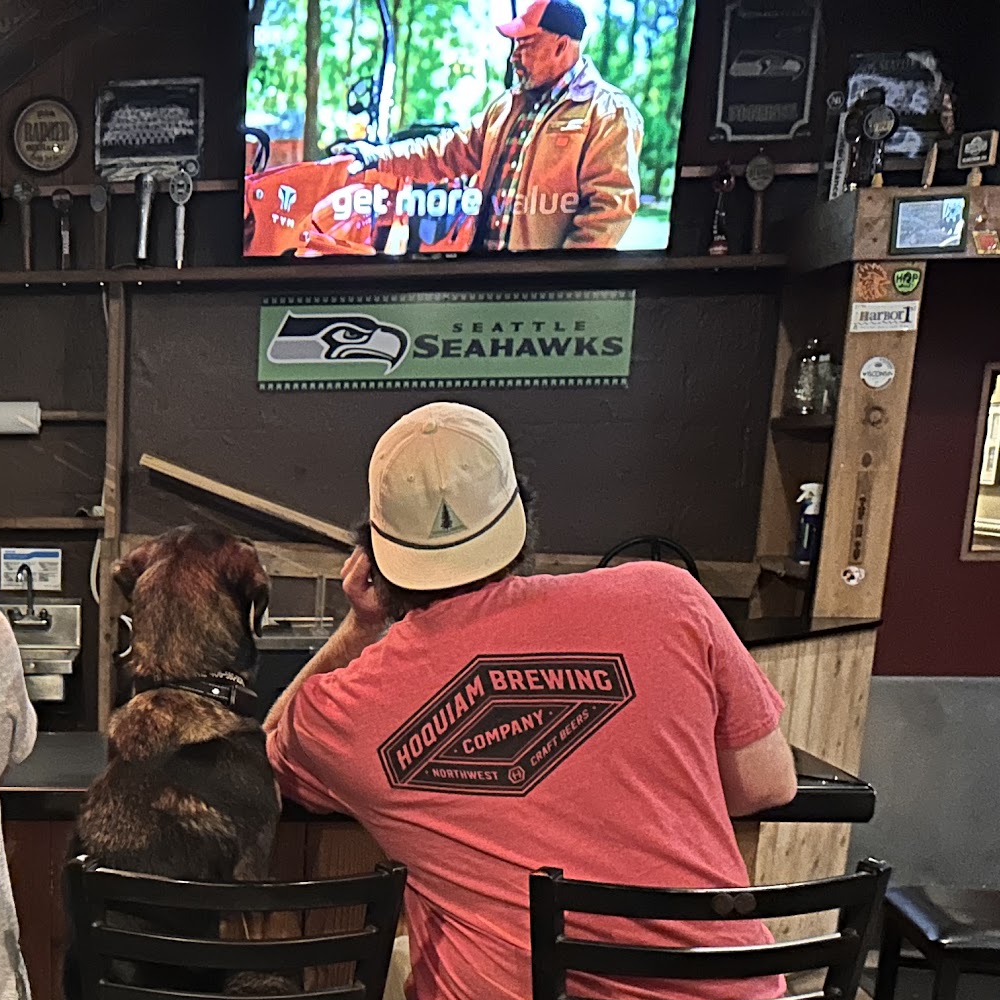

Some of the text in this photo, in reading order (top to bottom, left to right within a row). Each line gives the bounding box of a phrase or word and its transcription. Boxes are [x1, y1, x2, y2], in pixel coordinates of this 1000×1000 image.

[332, 185, 580, 220] get more value
[413, 334, 624, 359] SEAHAWKS
[452, 320, 586, 334] SEATTLE
[396, 668, 613, 770] HOQUIAM BREWING
[462, 709, 545, 755] COMPANY
[431, 767, 499, 781] NORTHWEST
[530, 739, 560, 767] CRAFT
[559, 709, 591, 741] BEERS
